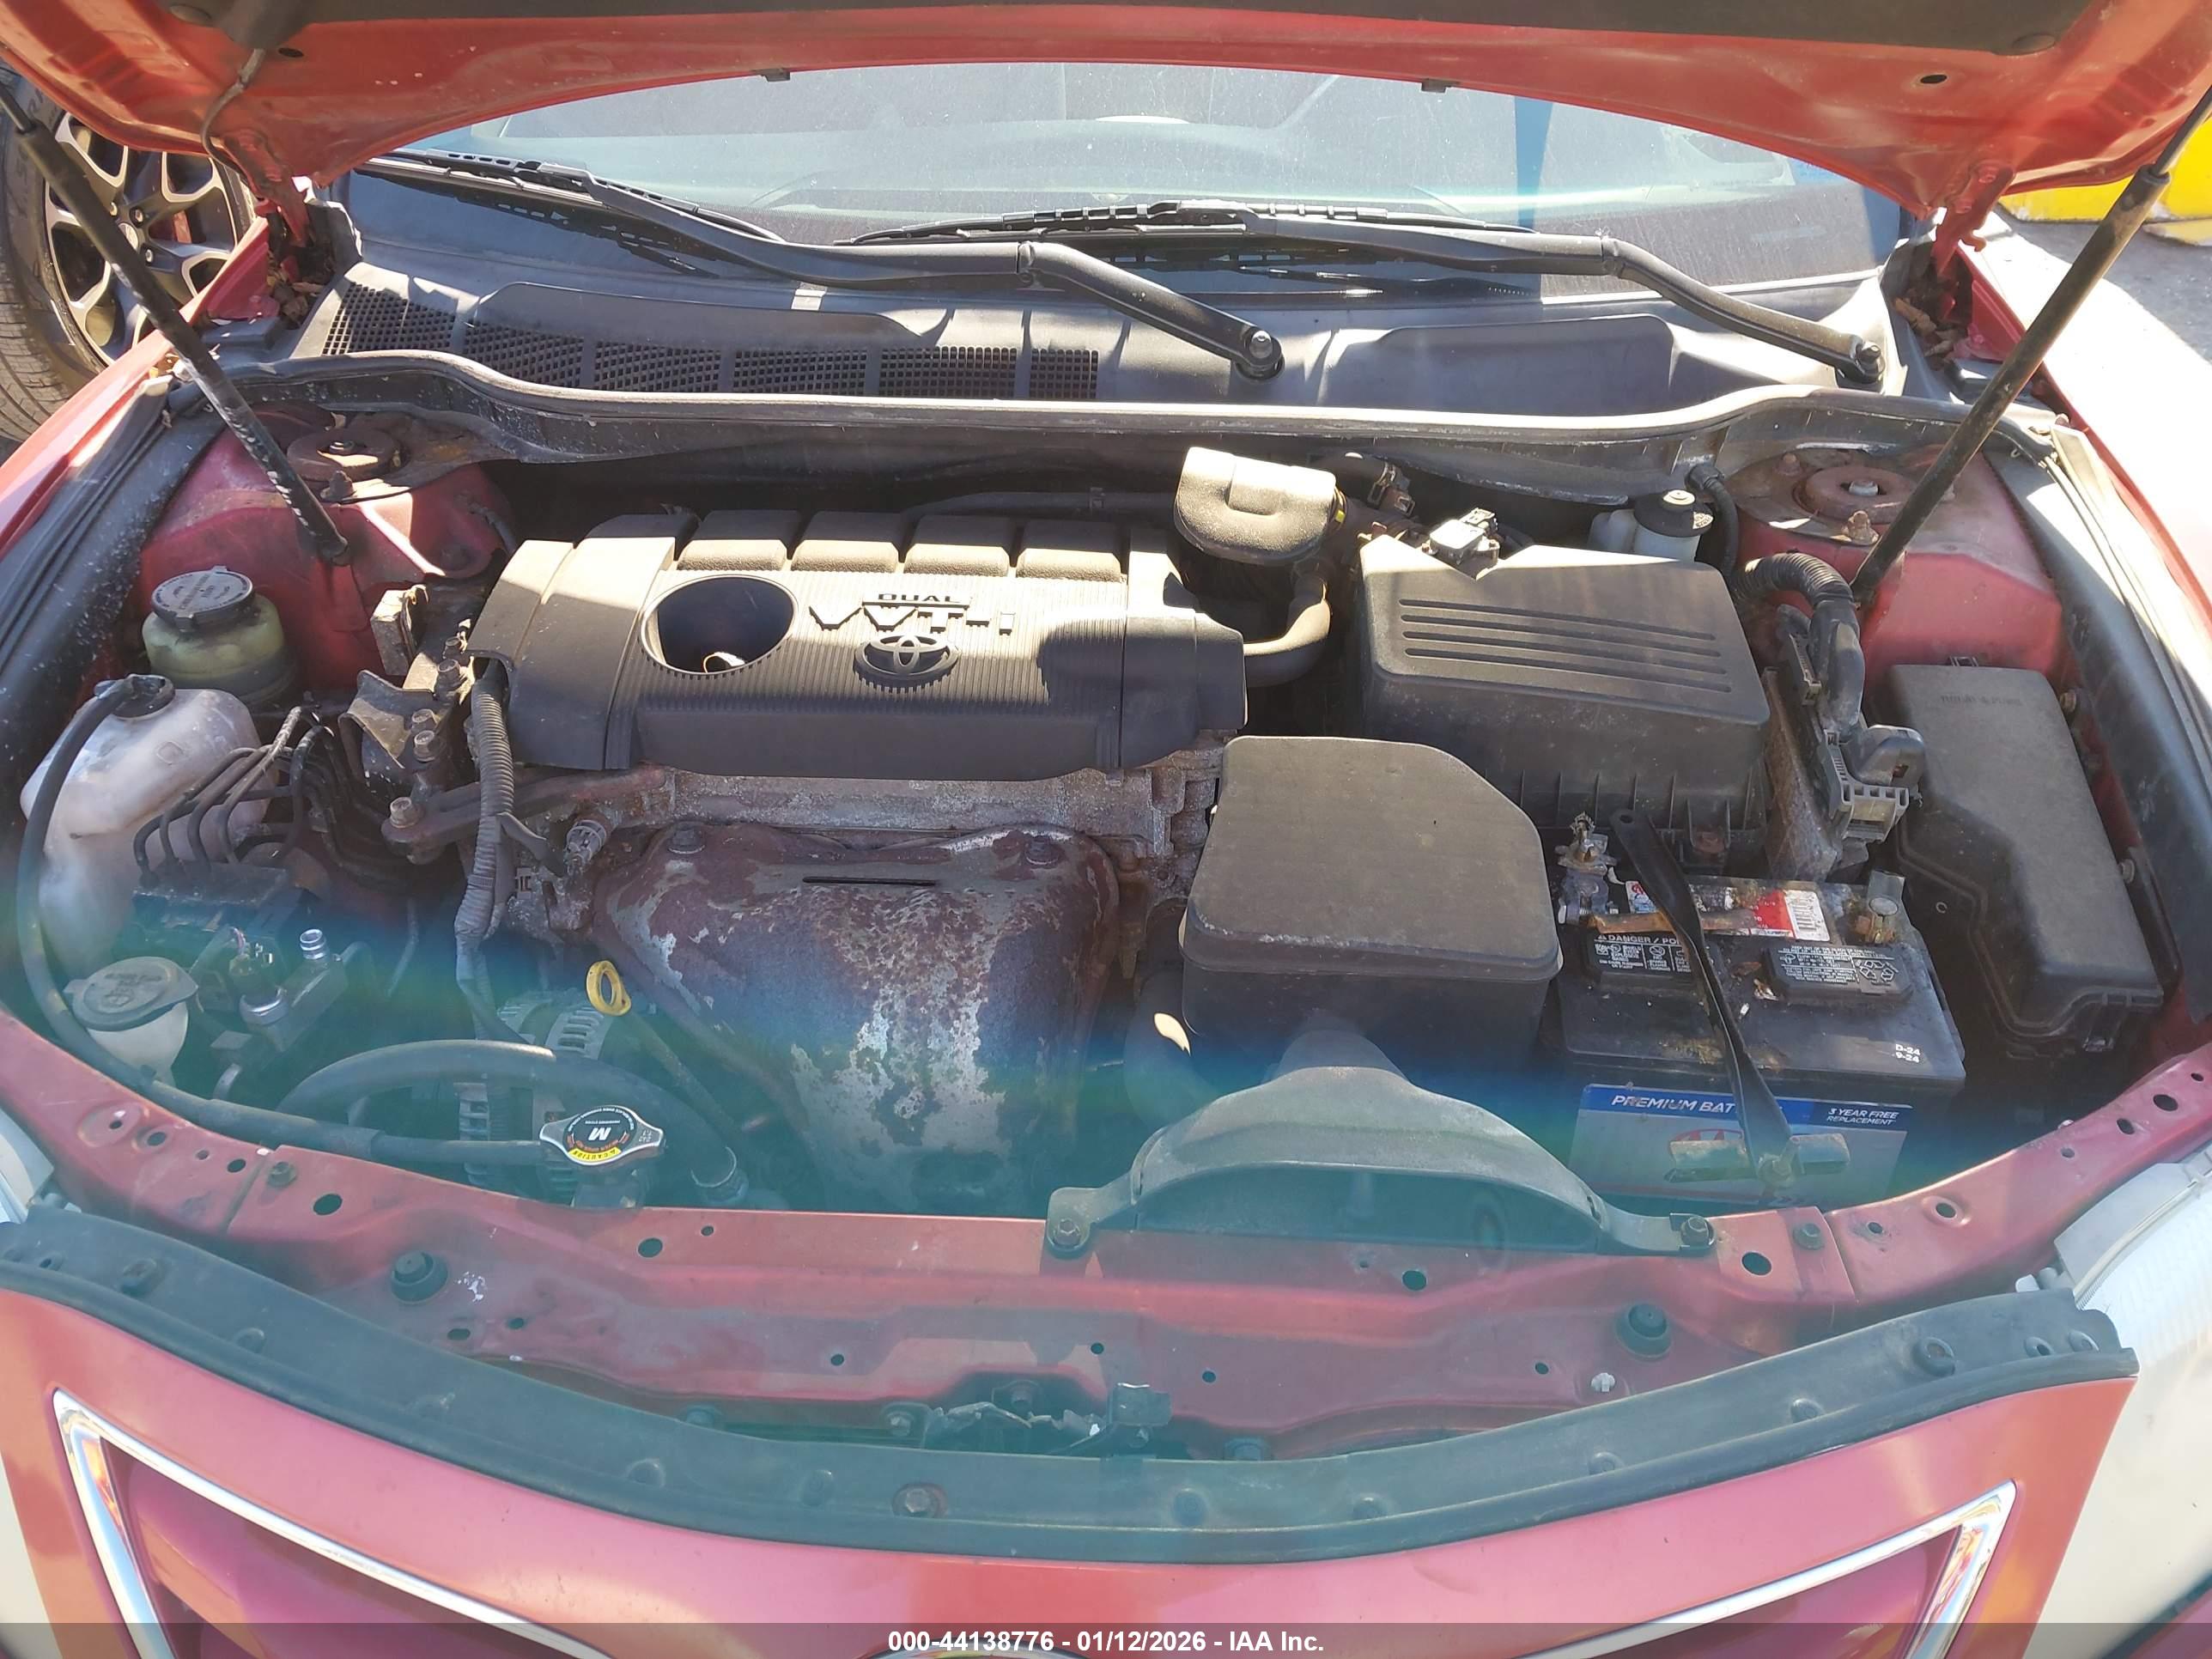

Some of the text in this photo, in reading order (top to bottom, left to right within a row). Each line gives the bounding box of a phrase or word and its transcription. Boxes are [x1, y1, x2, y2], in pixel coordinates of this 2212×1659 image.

[878, 592, 961, 604] DUAL
[1607, 934, 1650, 945] DANGER
[1895, 1043, 1921, 1056] D-24
[1611, 1095, 1738, 1115] PREMIUM BAT
[1838, 1108, 1869, 1117] YEAR
[1869, 1110, 1900, 1120] FREE
[1826, 1115, 1897, 1126] REPLACEMENT
